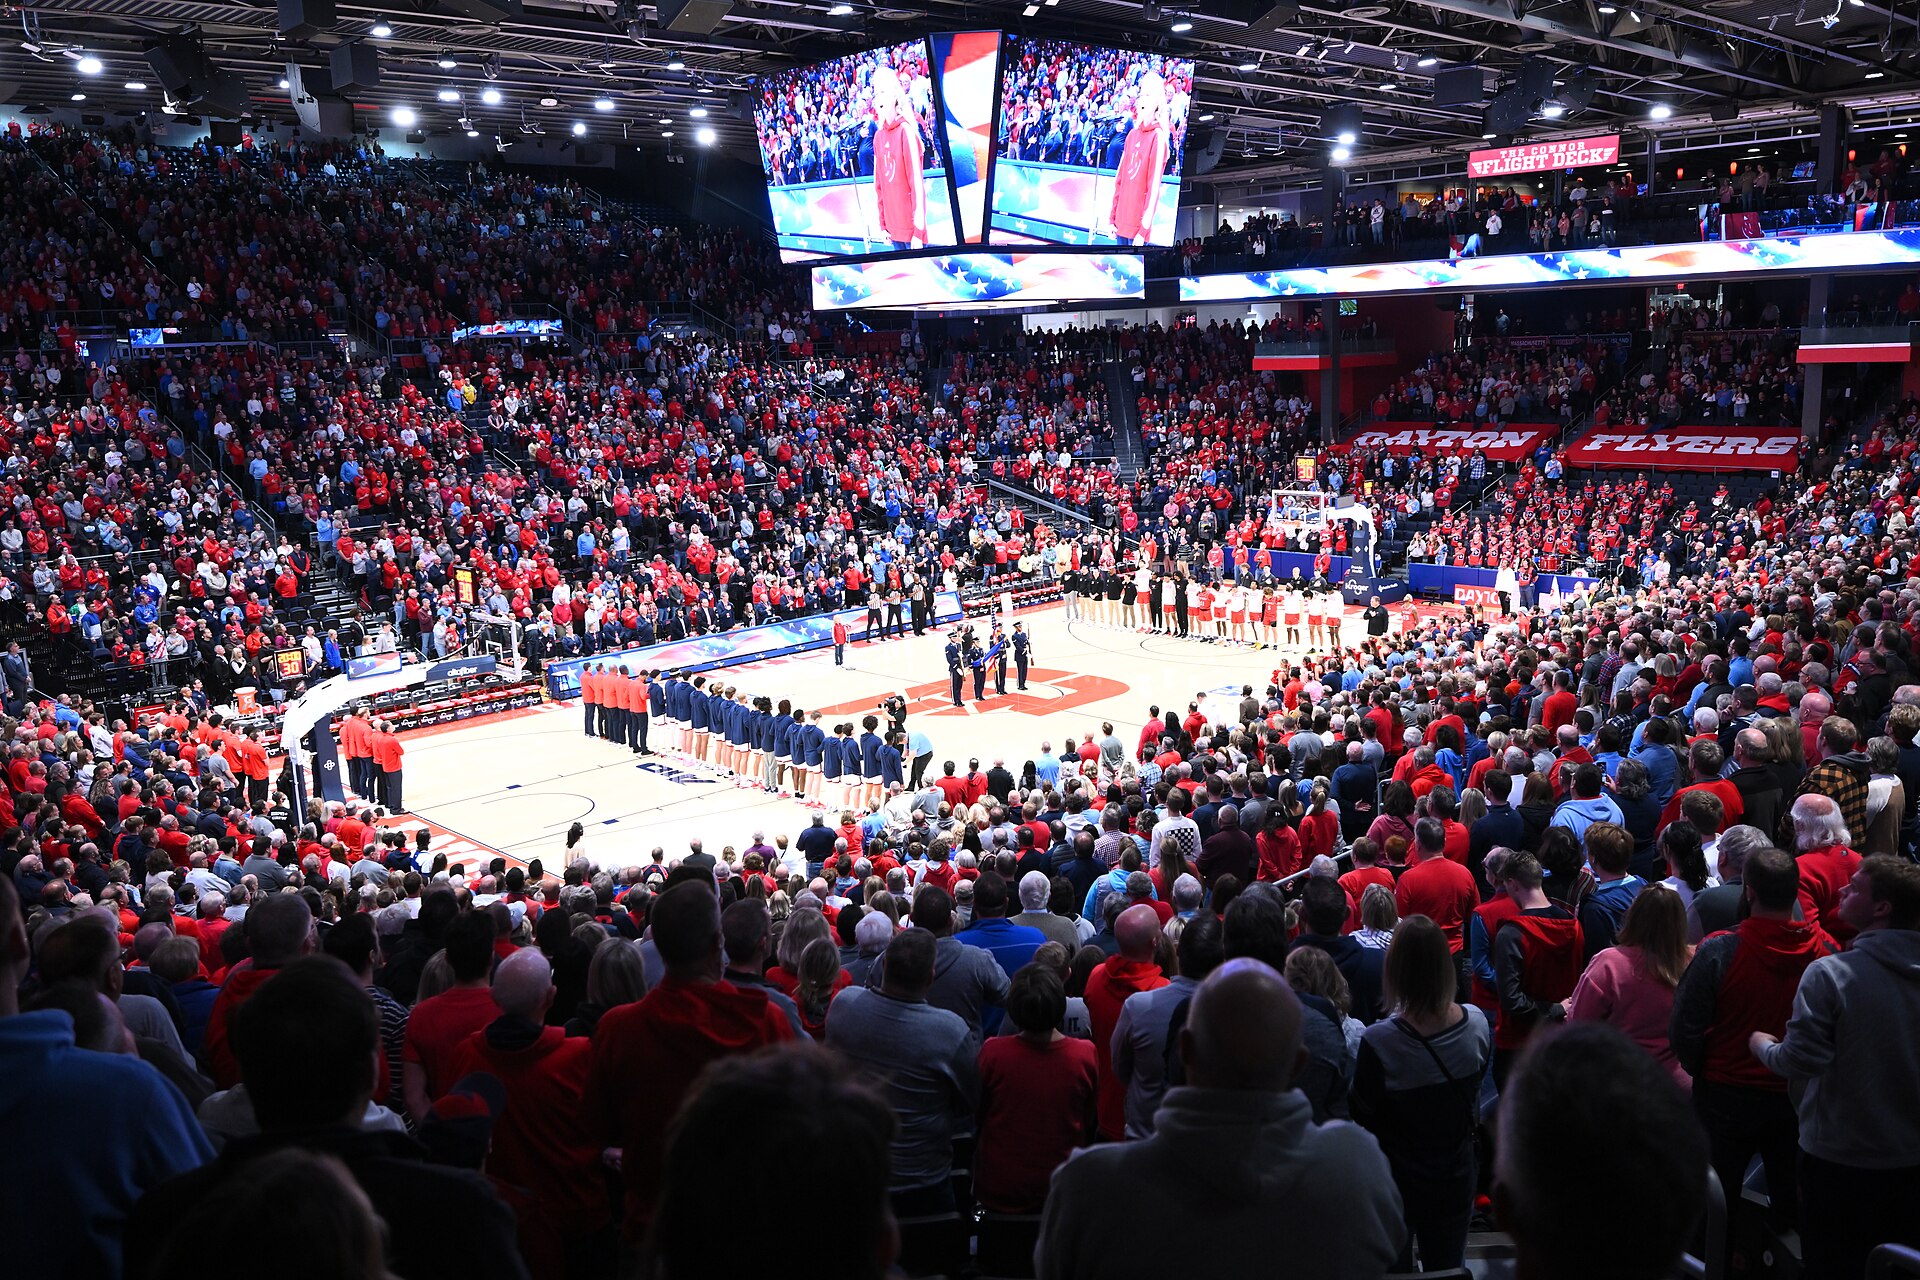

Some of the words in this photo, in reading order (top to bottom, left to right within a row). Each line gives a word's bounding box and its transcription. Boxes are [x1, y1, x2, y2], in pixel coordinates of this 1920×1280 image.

[1500, 149, 1525, 158] THE
[1531, 142, 1585, 155] CONNOR
[1481, 154, 1548, 174] FLIGHT
[1552, 148, 1606, 167] DECK
[1353, 429, 1539, 449] DAYTON
[1582, 433, 1799, 455] FLYERS
[1345, 579, 1370, 595] Kroger
[1455, 588, 1502, 605] DAYTO
[277, 651, 302, 664] 20:00
[283, 664, 300, 676] 30
